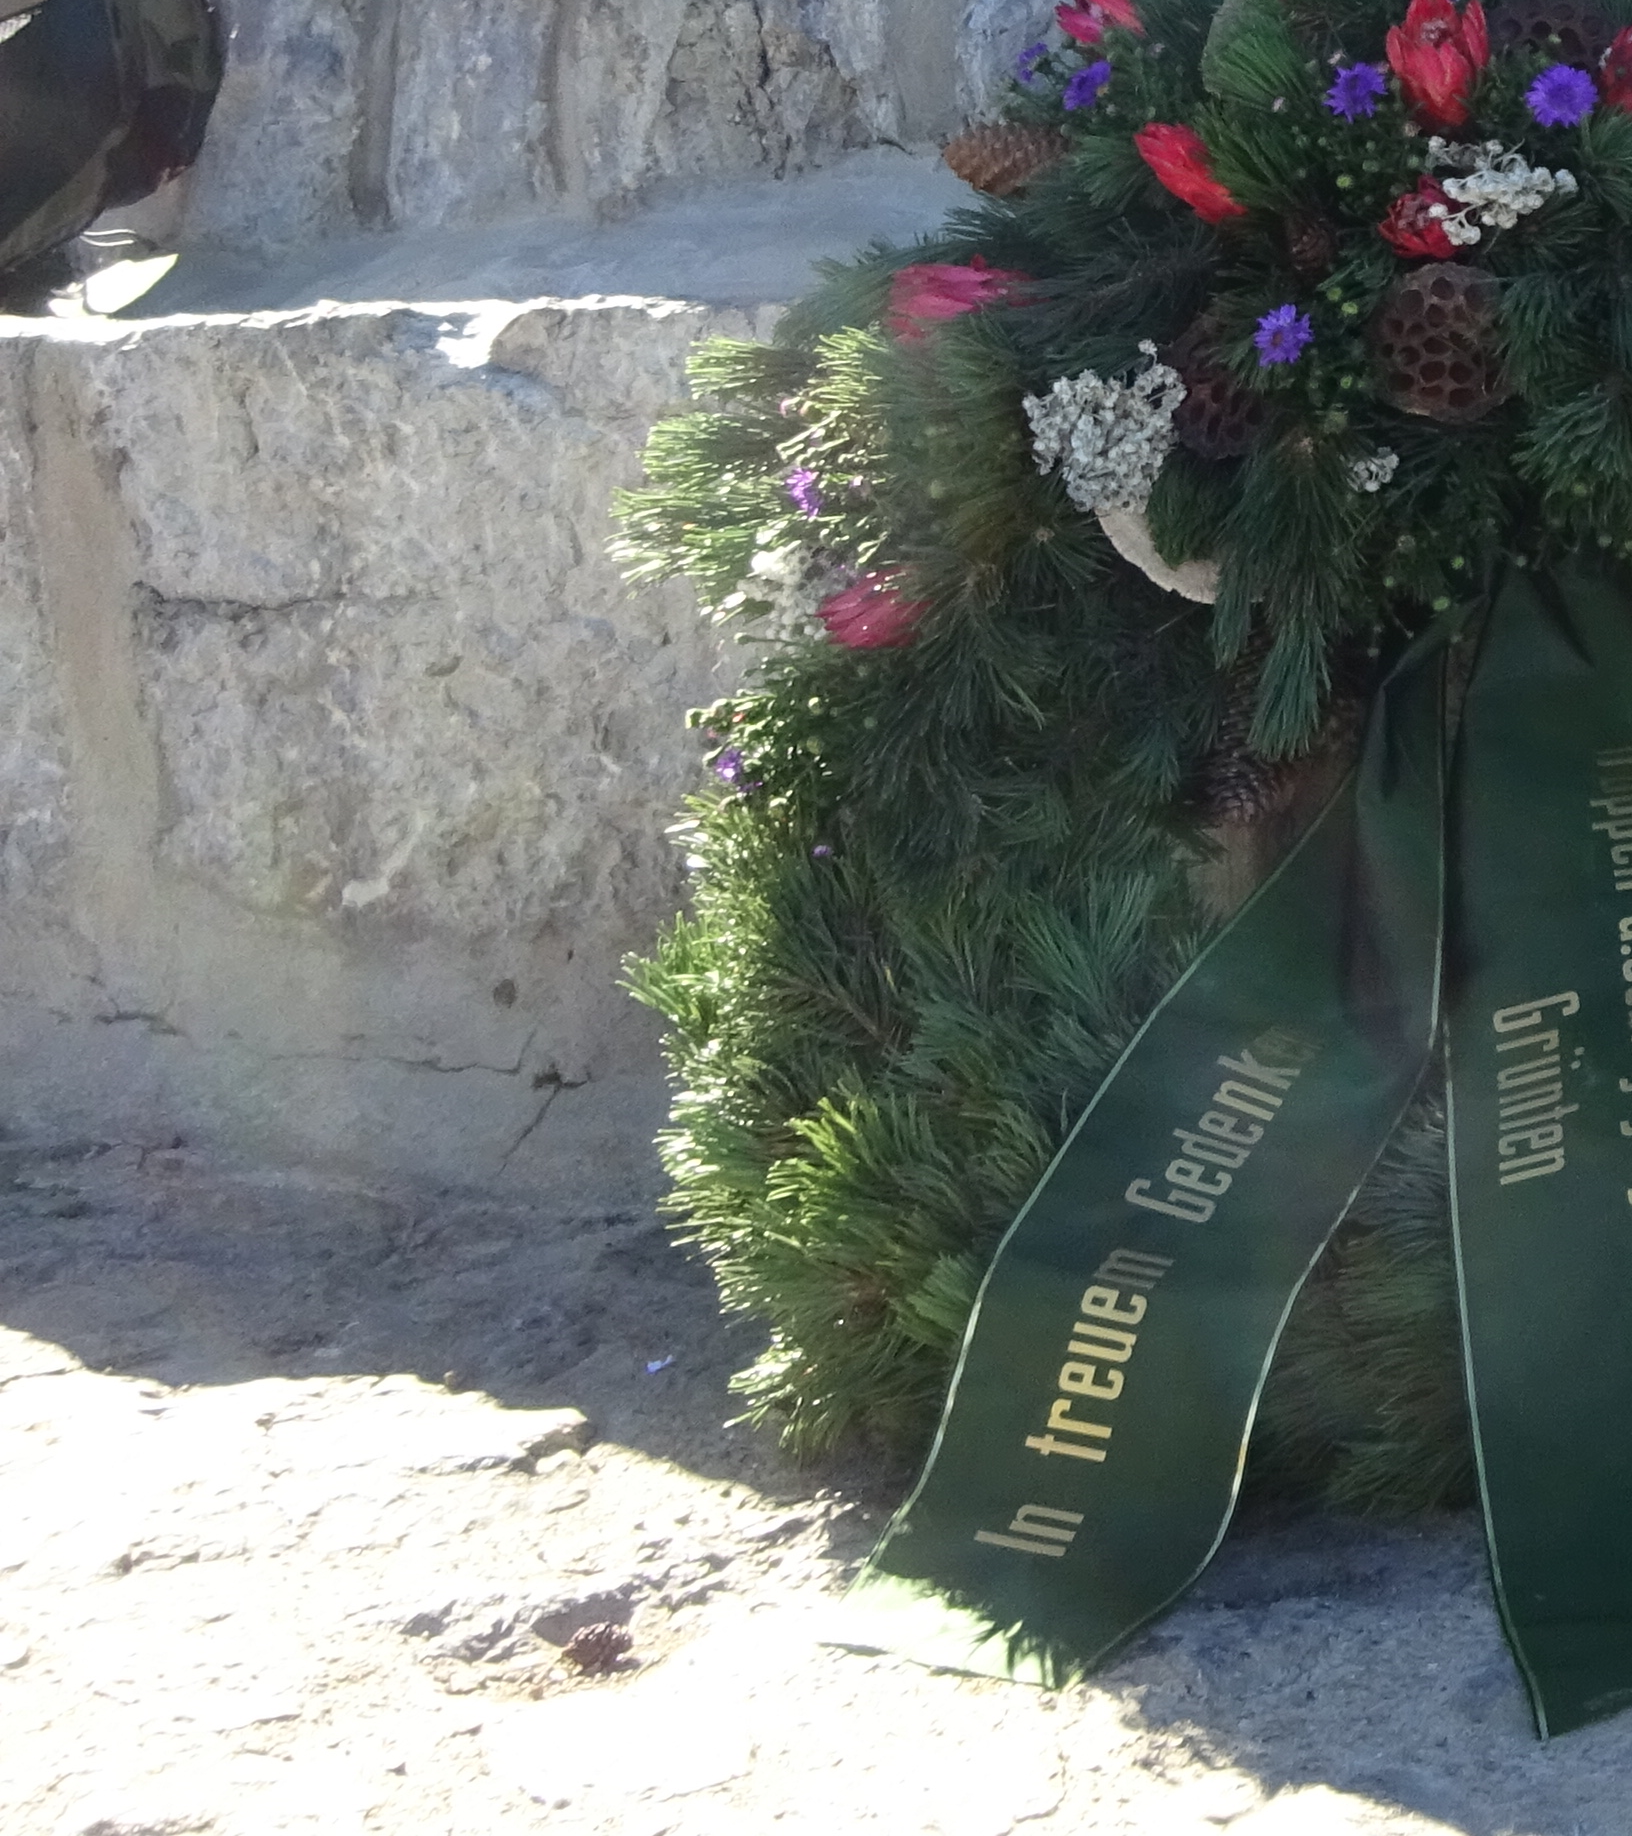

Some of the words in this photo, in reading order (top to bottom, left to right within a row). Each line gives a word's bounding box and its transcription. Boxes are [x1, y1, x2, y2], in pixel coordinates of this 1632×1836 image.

[1124, 1025, 1325, 1225] Gedenk
[1492, 988, 1581, 1187] Grünten
[1025, 1247, 1175, 1464] treuem
[974, 1501, 1085, 1559] In
